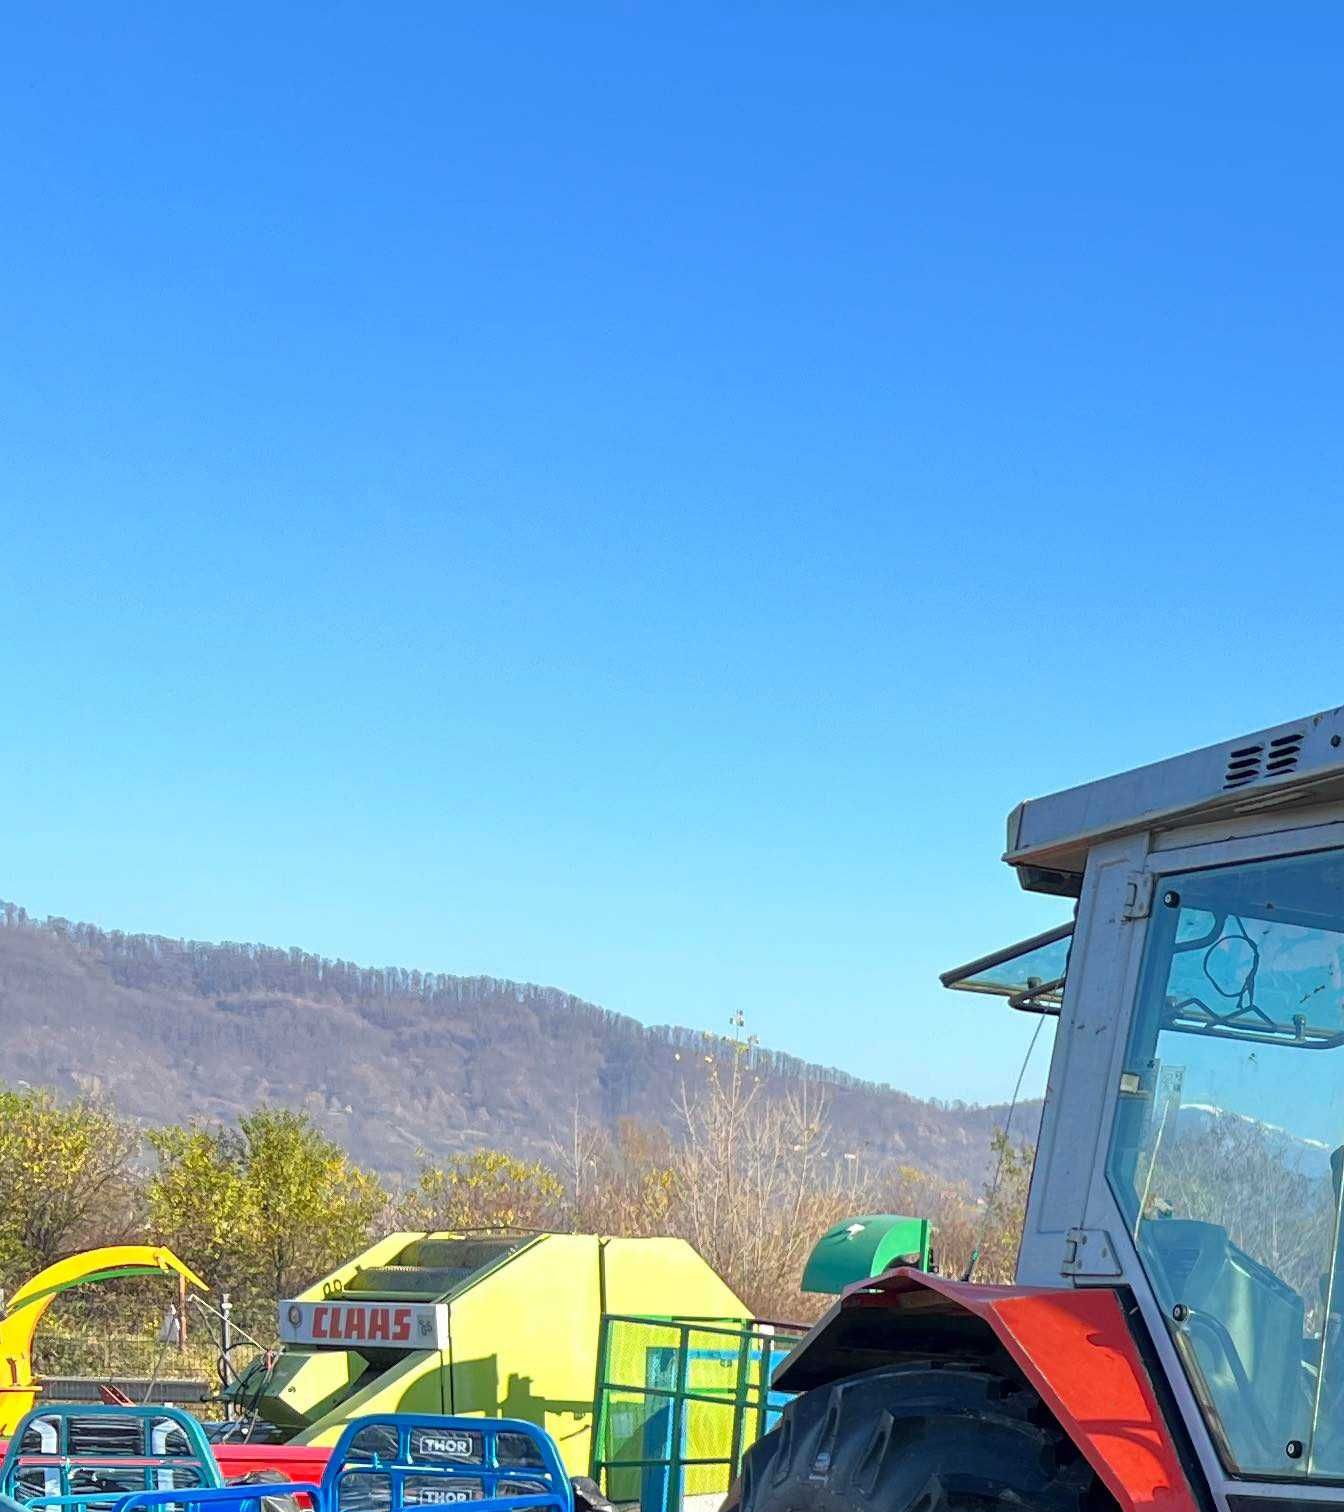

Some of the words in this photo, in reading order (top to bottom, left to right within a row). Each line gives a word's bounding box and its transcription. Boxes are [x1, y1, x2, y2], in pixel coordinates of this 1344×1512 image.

[312, 1307, 411, 1340] CLAAS
[426, 1438, 467, 1453] THOR
[426, 1491, 467, 1503] THOR
